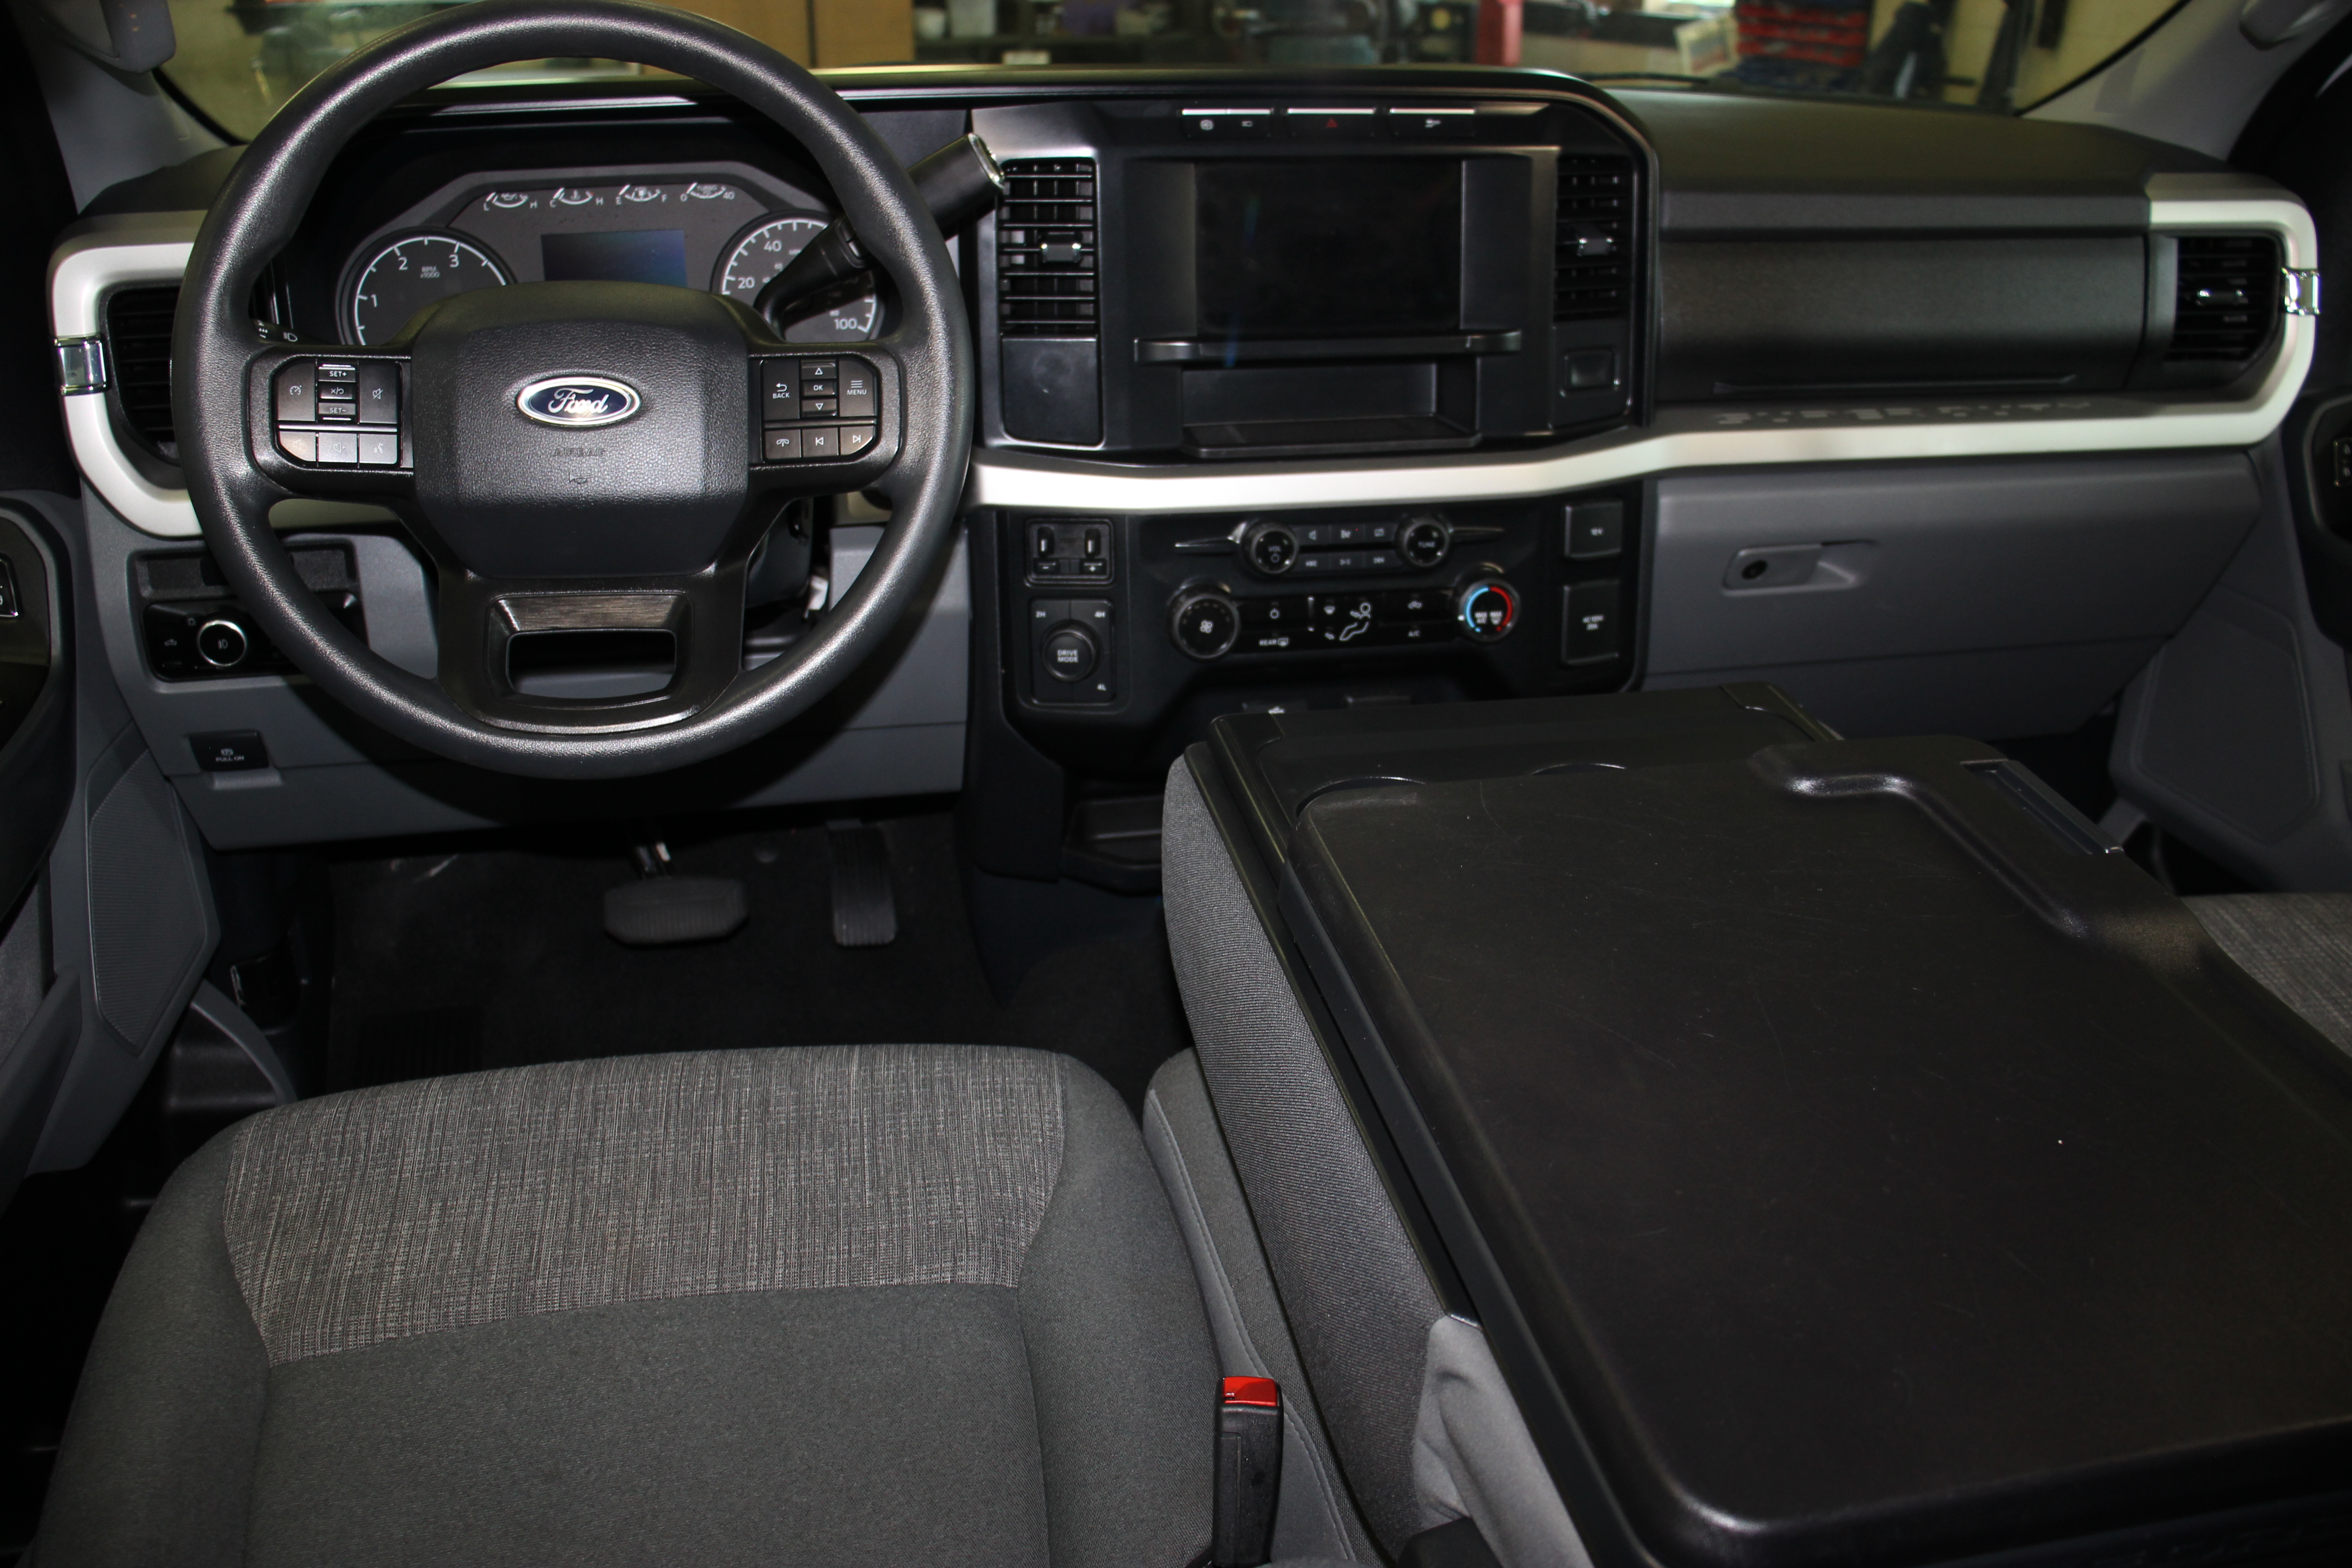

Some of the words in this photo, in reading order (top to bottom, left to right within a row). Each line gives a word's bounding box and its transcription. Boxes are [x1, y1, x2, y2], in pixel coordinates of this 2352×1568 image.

[661, 194, 667, 203] F
[723, 191, 735, 200] 40
[529, 200, 538, 209] H
[549, 199, 556, 208] C
[596, 197, 604, 205] H
[616, 196, 622, 205] E
[484, 203, 490, 211] L
[764, 240, 782, 252] 40
[399, 257, 408, 270] 2
[449, 255, 459, 268] 3
[738, 277, 755, 289] 20
[371, 294, 378, 307] 1
[834, 319, 858, 330] 100
[548, 387, 610, 413] Ford
[553, 448, 605, 456] AIRBAG
